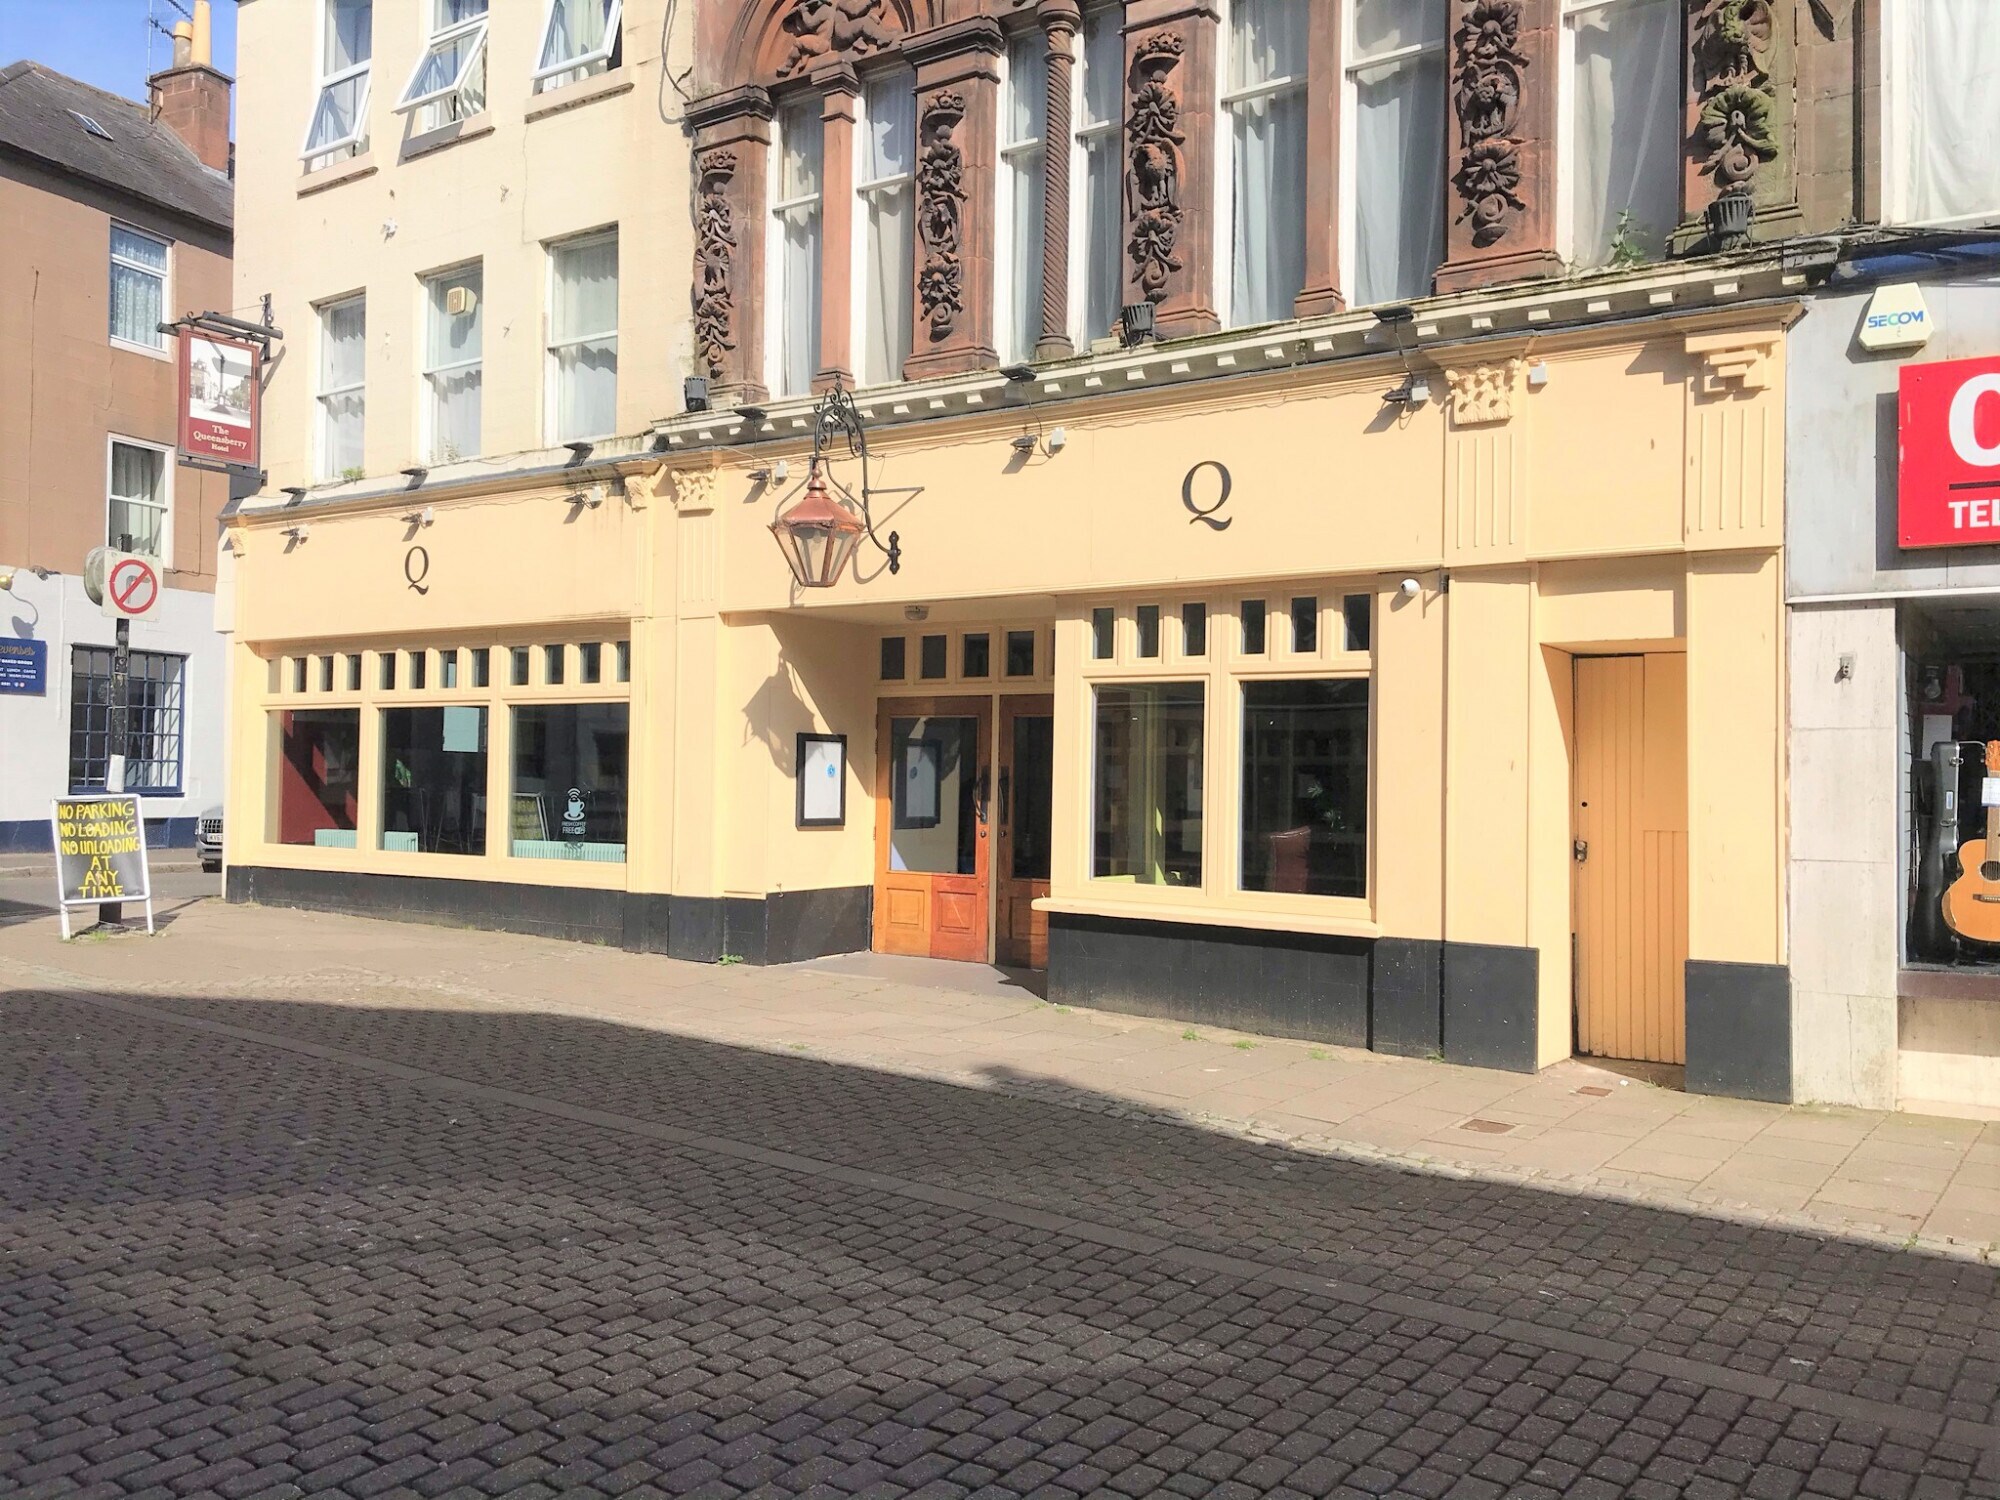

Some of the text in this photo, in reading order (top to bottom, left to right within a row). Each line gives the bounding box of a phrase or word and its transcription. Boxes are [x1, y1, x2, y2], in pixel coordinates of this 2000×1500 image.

[1868, 310, 1924, 328] SECOM
[212, 424, 229, 435] The
[193, 430, 247, 450] Queensberry
[212, 443, 229, 452] Hotel
[1181, 460, 1232, 531] Q
[404, 545, 429, 596] Q
[59, 801, 135, 820] NO PARKING
[60, 819, 137, 837] NO LOADING
[61, 840, 78, 855] NO
[90, 855, 112, 871] AT
[84, 869, 119, 886] ANY
[78, 884, 126, 899] TIME
